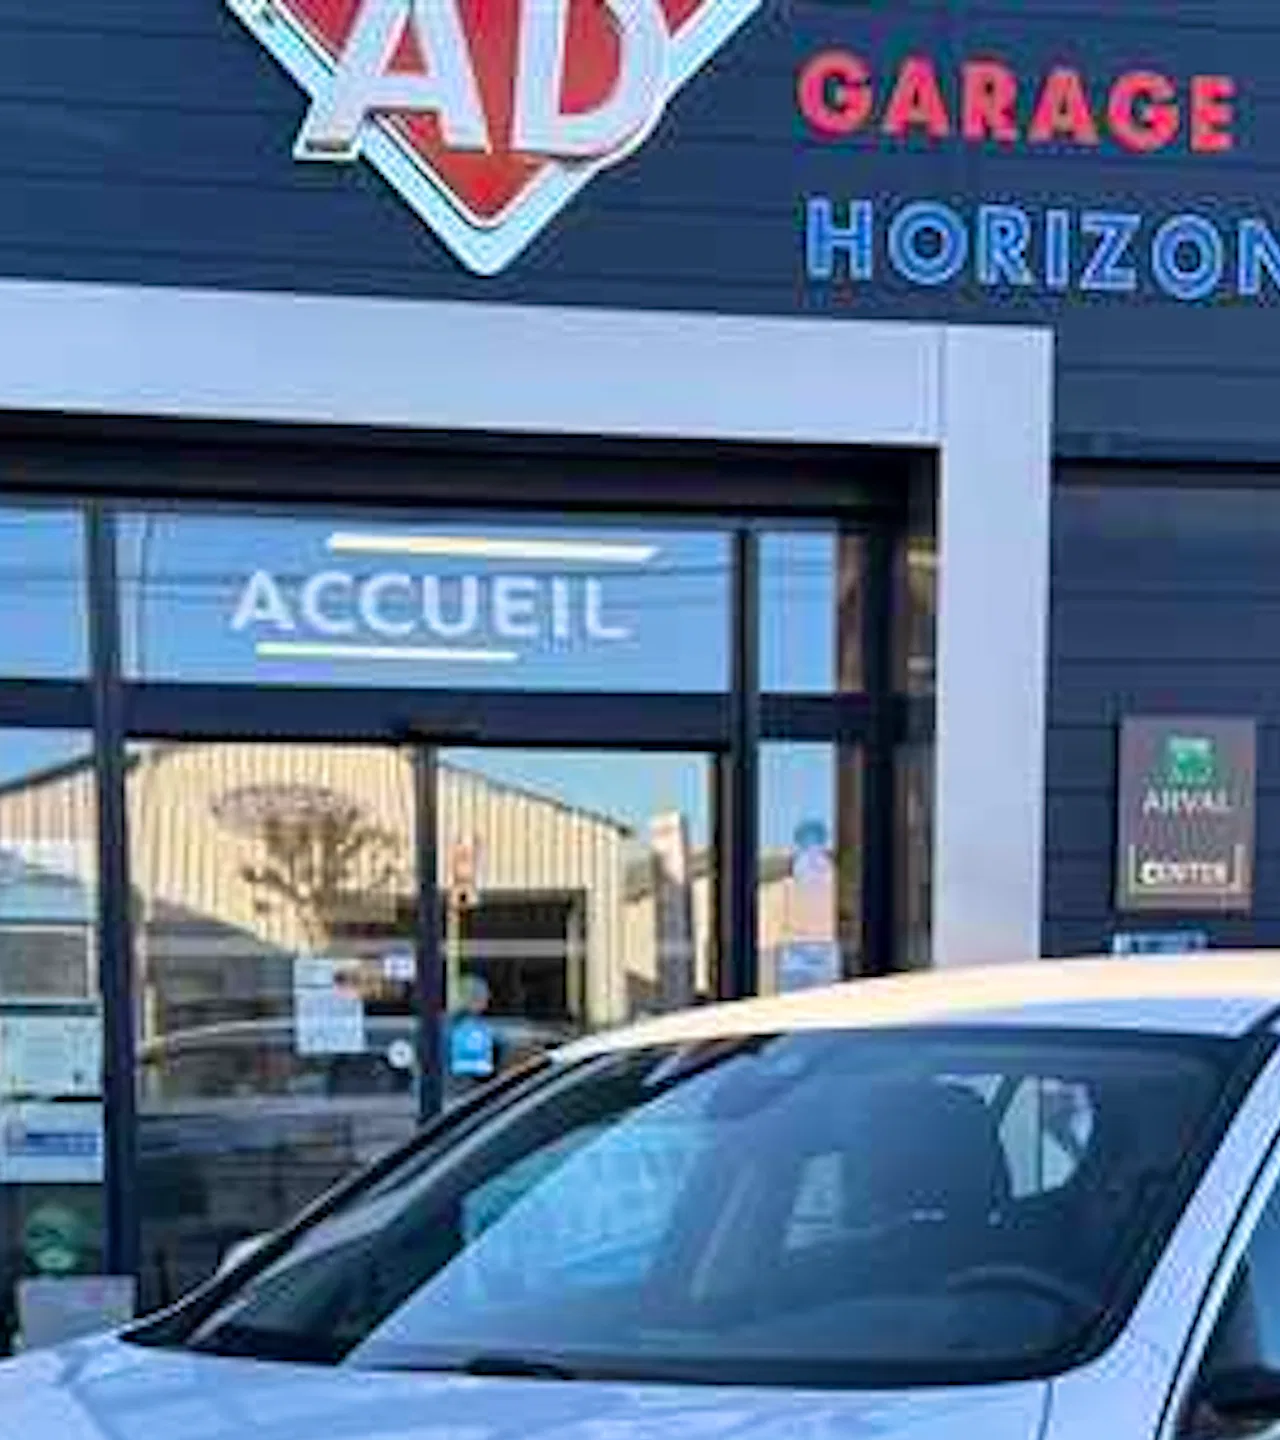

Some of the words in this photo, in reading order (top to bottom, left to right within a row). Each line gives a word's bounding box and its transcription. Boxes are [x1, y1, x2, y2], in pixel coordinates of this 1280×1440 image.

[296, 0, 670, 160] AD
[797, 50, 1235, 153] GARAGE
[231, 570, 635, 641] ACCUEIL
